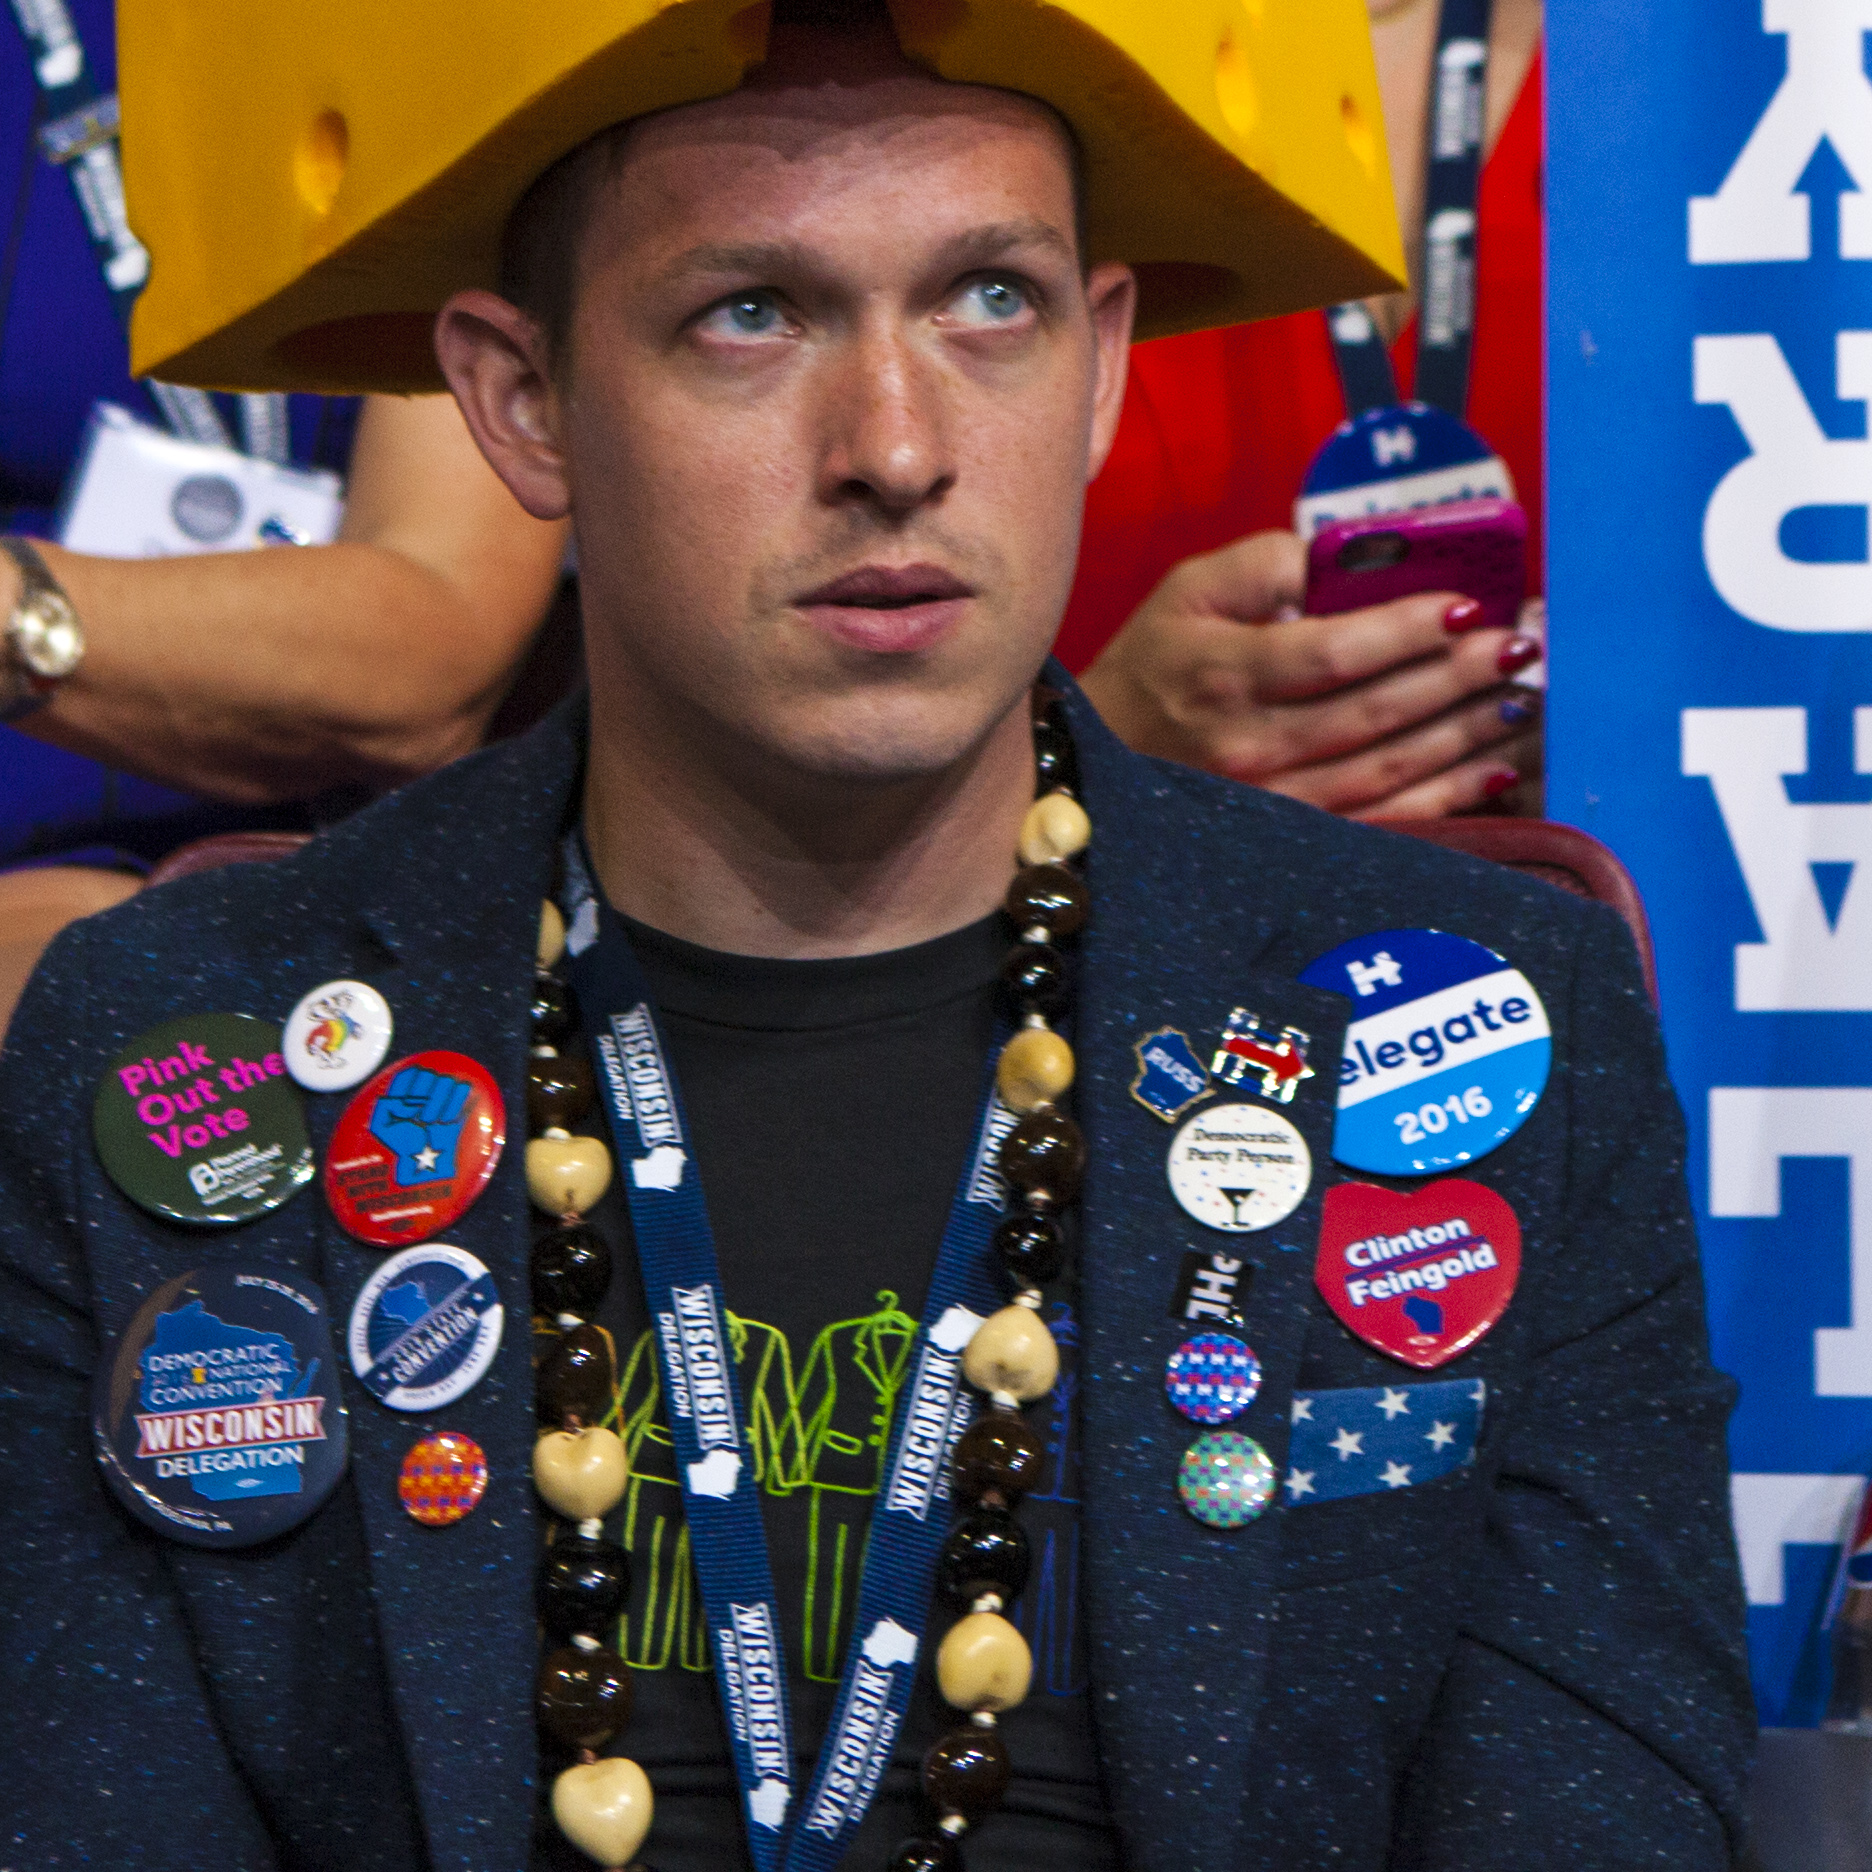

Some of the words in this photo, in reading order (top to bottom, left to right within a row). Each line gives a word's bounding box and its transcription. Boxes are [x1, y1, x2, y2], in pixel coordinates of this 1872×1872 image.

[118, 1041, 215, 1096] Pink
[1339, 992, 1531, 1088] elegate
[137, 1078, 220, 1126] Out
[218, 1052, 286, 1093] the
[597, 1036, 633, 1119] DELEGATION
[621, 1011, 674, 1140] WISCONSIN
[147, 1108, 251, 1158] Vote
[1193, 1127, 1291, 1145] Democratic
[1393, 1085, 1492, 1144] 2016
[1187, 1147, 1232, 1165] Party
[1237, 1148, 1295, 1165] Person
[1345, 1217, 1471, 1270] Clinton
[1347, 1243, 1497, 1308] Feingold
[148, 1342, 280, 1372] DEMOCRATIC
[208, 1360, 293, 1380] NATIONAL
[392, 1306, 480, 1384] CONVENTION
[658, 1313, 692, 1418] DELEGATION
[678, 1292, 732, 1447] WISCONSIN
[148, 1378, 283, 1406] CONVENTION
[142, 1401, 317, 1453] WISCONSIN
[155, 1444, 305, 1478] DELEGATION
[894, 1358, 957, 1509] WISCONSIN
[718, 1628, 748, 1742] DELEGATION
[736, 1607, 785, 1771] WISCONSIN
[813, 1674, 889, 1830] WISCONSIN
[848, 1708, 901, 1823] DELEGATION
